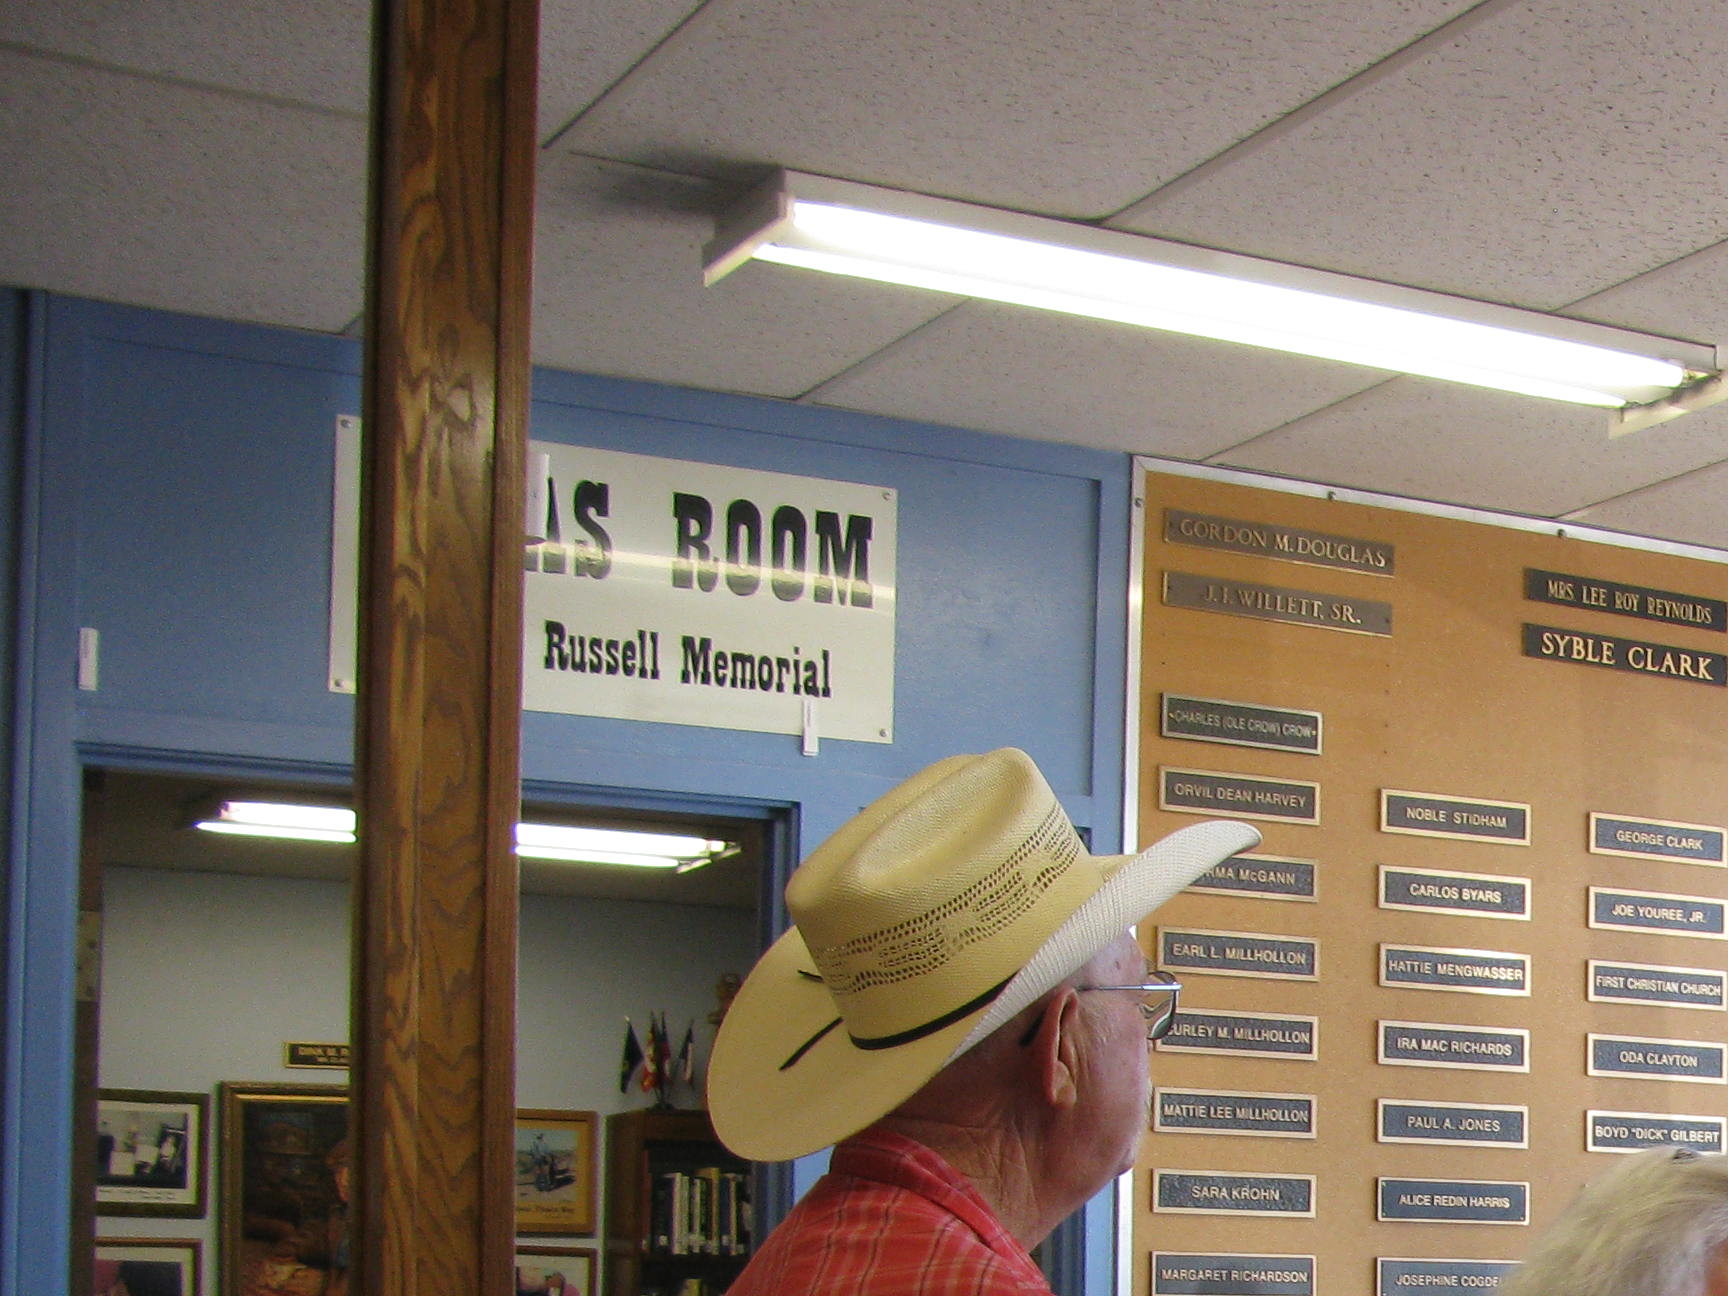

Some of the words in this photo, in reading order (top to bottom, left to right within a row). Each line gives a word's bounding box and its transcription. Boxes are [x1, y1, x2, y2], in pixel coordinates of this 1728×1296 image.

[672, 491, 874, 609] ROOM
[1180, 519, 1266, 547] GORDON
[1274, 534, 1294, 552] M.
[1297, 537, 1386, 568] DOUGLAS
[1331, 603, 1363, 624] SR.
[1582, 586, 1608, 607] LEE
[1615, 591, 1640, 612] ROY
[1647, 597, 1713, 624] REYNOLDS
[543, 619, 661, 680] Russell
[680, 635, 832, 698] Memorial
[1541, 632, 1615, 665] SYBLE
[1627, 646, 1715, 681] CLARK
[1174, 709, 1220, 728] CHARLES
[1222, 716, 1245, 731] (OLE
[1248, 719, 1281, 737] CROW)
[1282, 722, 1312, 738] CROW
[1174, 783, 1214, 799] ORVIL
[1217, 786, 1252, 802] DEAN
[1255, 791, 1307, 808] HARVEY
[1406, 806, 1447, 823] NOBLE
[1453, 811, 1507, 829] STIDHAM
[1616, 830, 1664, 847] GEORGE
[1666, 835, 1704, 850] CLARK
[1205, 865, 1234, 878] RMA
[1239, 867, 1296, 886] McGANN
[1409, 883, 1459, 900] CARLOS
[1461, 887, 1503, 904] BYARS
[1611, 904, 1635, 917] JOE
[1688, 911, 1708, 924] JR.
[1172, 943, 1207, 958] EARL
[1225, 947, 1306, 965] MILLHOLLON
[1388, 959, 1432, 974] HATTIE
[1436, 962, 1524, 981] MENGWASSER
[1596, 975, 1625, 989] FIRST
[1626, 977, 1679, 993] CHRISTIAN
[1680, 981, 1722, 997] CHURCH
[1234, 1027, 1310, 1044] MILLHOLLON
[1397, 1036, 1421, 1050] IRA
[1421, 1038, 1448, 1052] MAC
[1451, 1040, 1513, 1057] RICHARDS
[1619, 1050, 1644, 1064] ODA
[1646, 1052, 1699, 1068] CLAYTON
[1163, 1103, 1206, 1118] MATTIE
[1209, 1106, 1233, 1119] LEE
[1235, 1106, 1309, 1122] MILLHOLLON
[1407, 1115, 1440, 1129] PAUL
[1458, 1118, 1501, 1132] JONES
[1595, 1125, 1629, 1138] BOYD
[1670, 1129, 1720, 1143] GILBERT
[1191, 1185, 1228, 1199] SARA
[1231, 1186, 1280, 1200] KROHN
[1399, 1194, 1432, 1206] ALICE
[1433, 1195, 1468, 1207] REDIN
[1469, 1196, 1510, 1209] HARRIS
[1161, 1268, 1228, 1281] MARGARET
[1230, 1269, 1308, 1283] RICHARDSON
[1396, 1274, 1459, 1287] JOSEPHINE
[1460, 1275, 1501, 1288] COGDE
